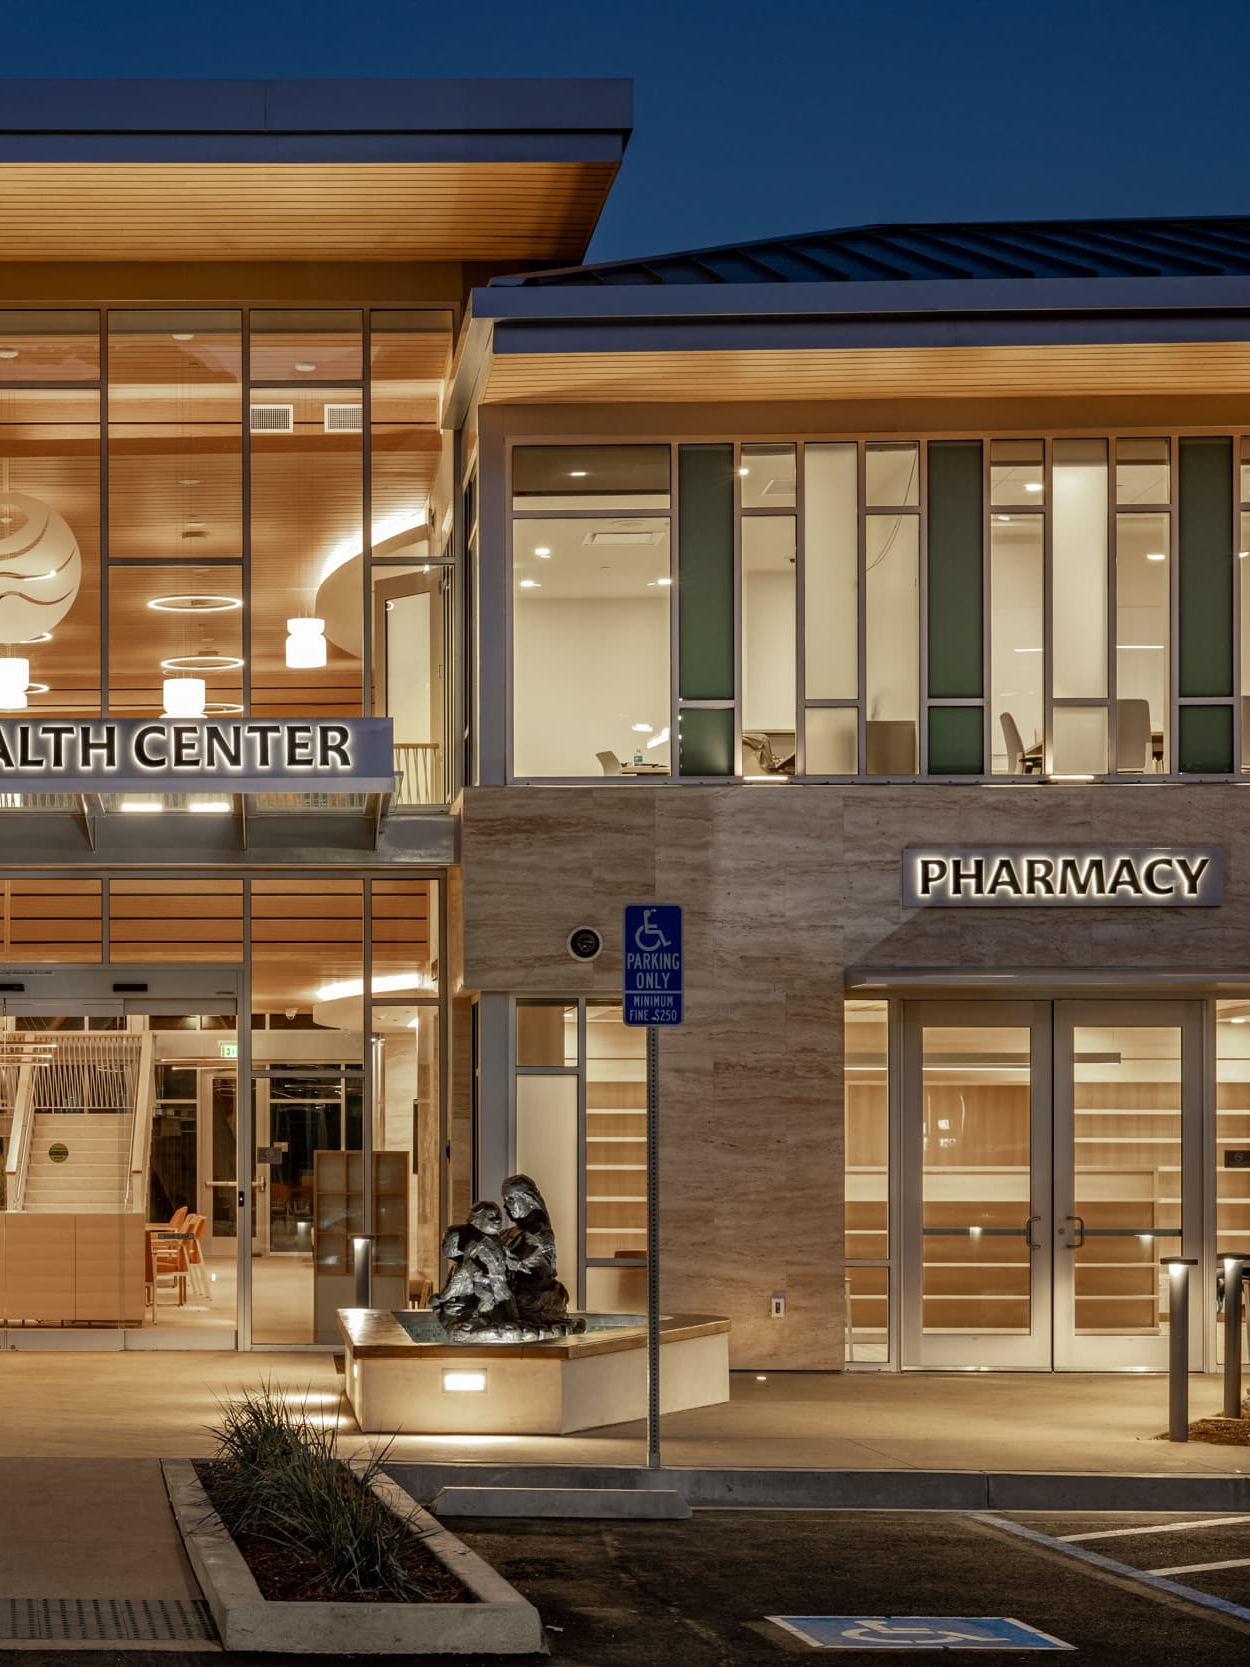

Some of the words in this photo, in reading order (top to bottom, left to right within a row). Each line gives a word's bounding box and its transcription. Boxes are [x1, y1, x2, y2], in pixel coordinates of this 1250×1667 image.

[133, 726, 353, 770] CENTER
[919, 857, 1210, 896] PHARMACY
[627, 953, 680, 970] PARKING
[636, 972, 671, 989] ONLY
[633, 995, 674, 1007] MINIMUM
[629, 1009, 648, 1022] FINE
[654, 1009, 677, 1022] $250
